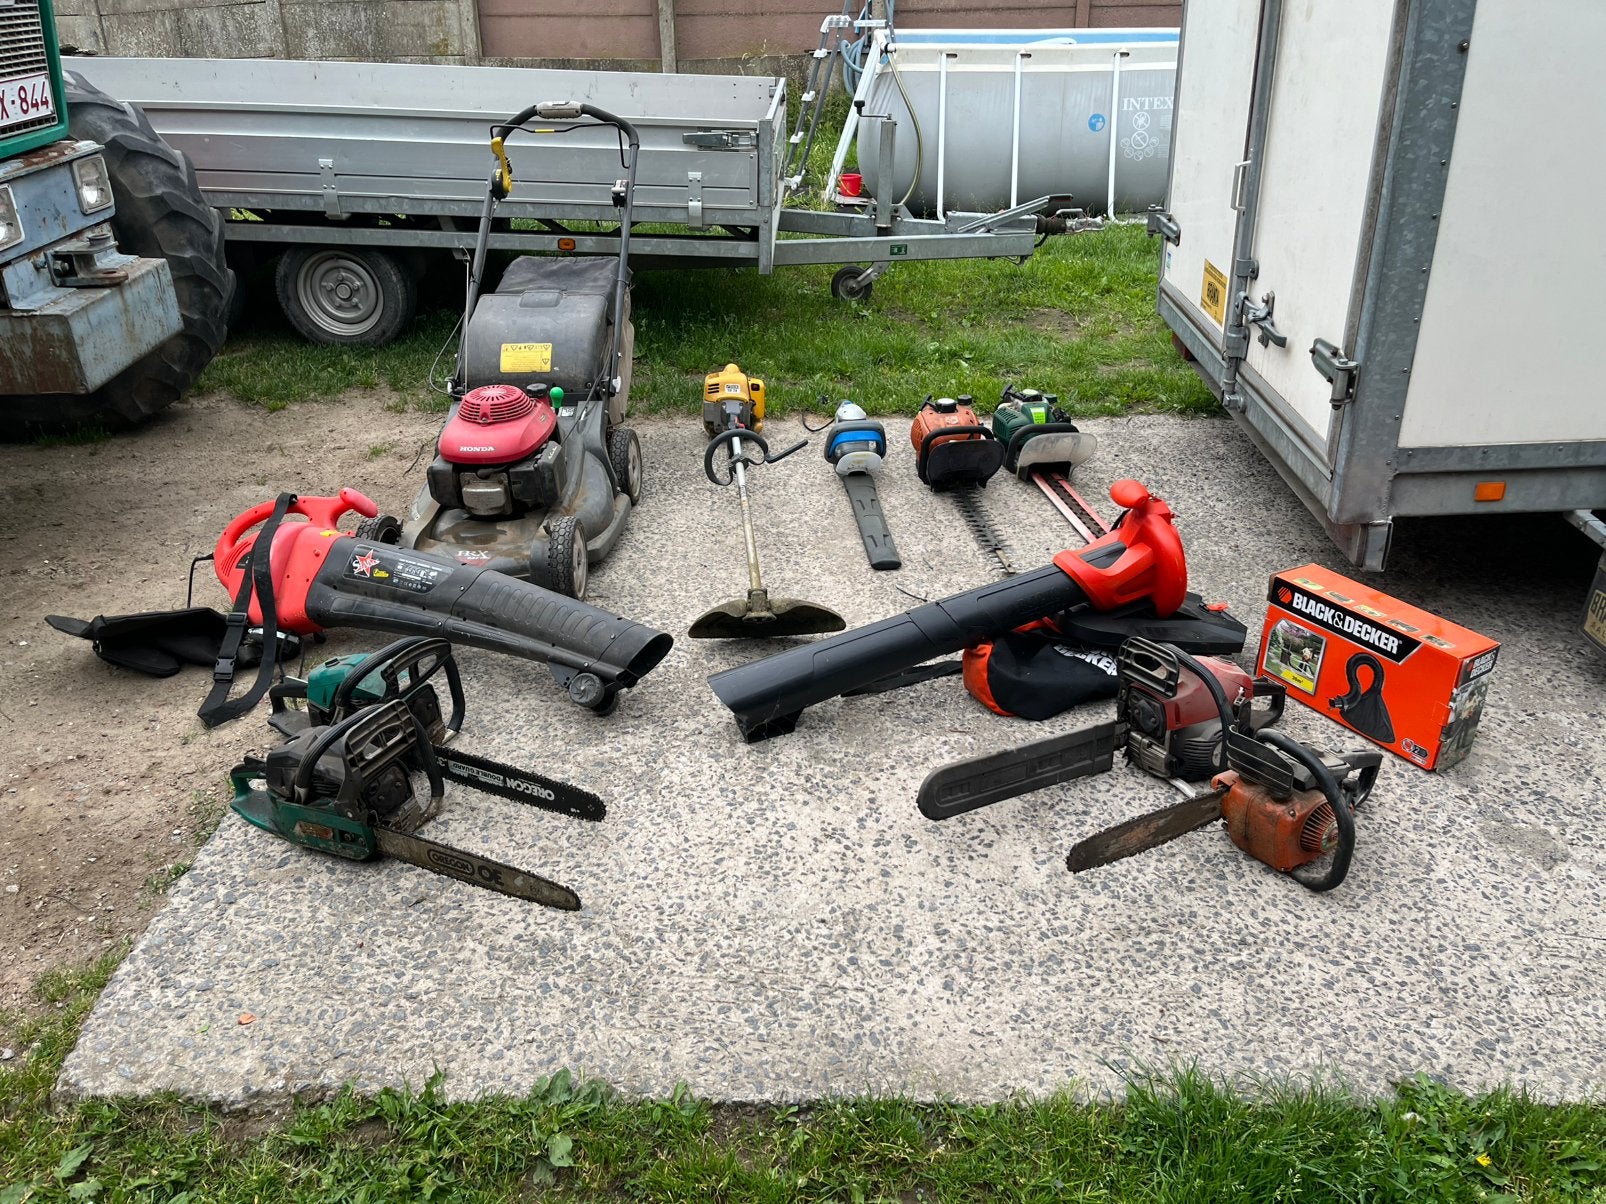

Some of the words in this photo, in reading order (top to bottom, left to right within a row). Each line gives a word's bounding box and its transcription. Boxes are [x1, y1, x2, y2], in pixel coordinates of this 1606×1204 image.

[1121, 96, 1174, 111] INTEX
[452, 762, 476, 776] GUARD
[476, 769, 501, 782] DOUBLE
[505, 777, 555, 801] OREGON
[432, 852, 471, 874] OREGON
